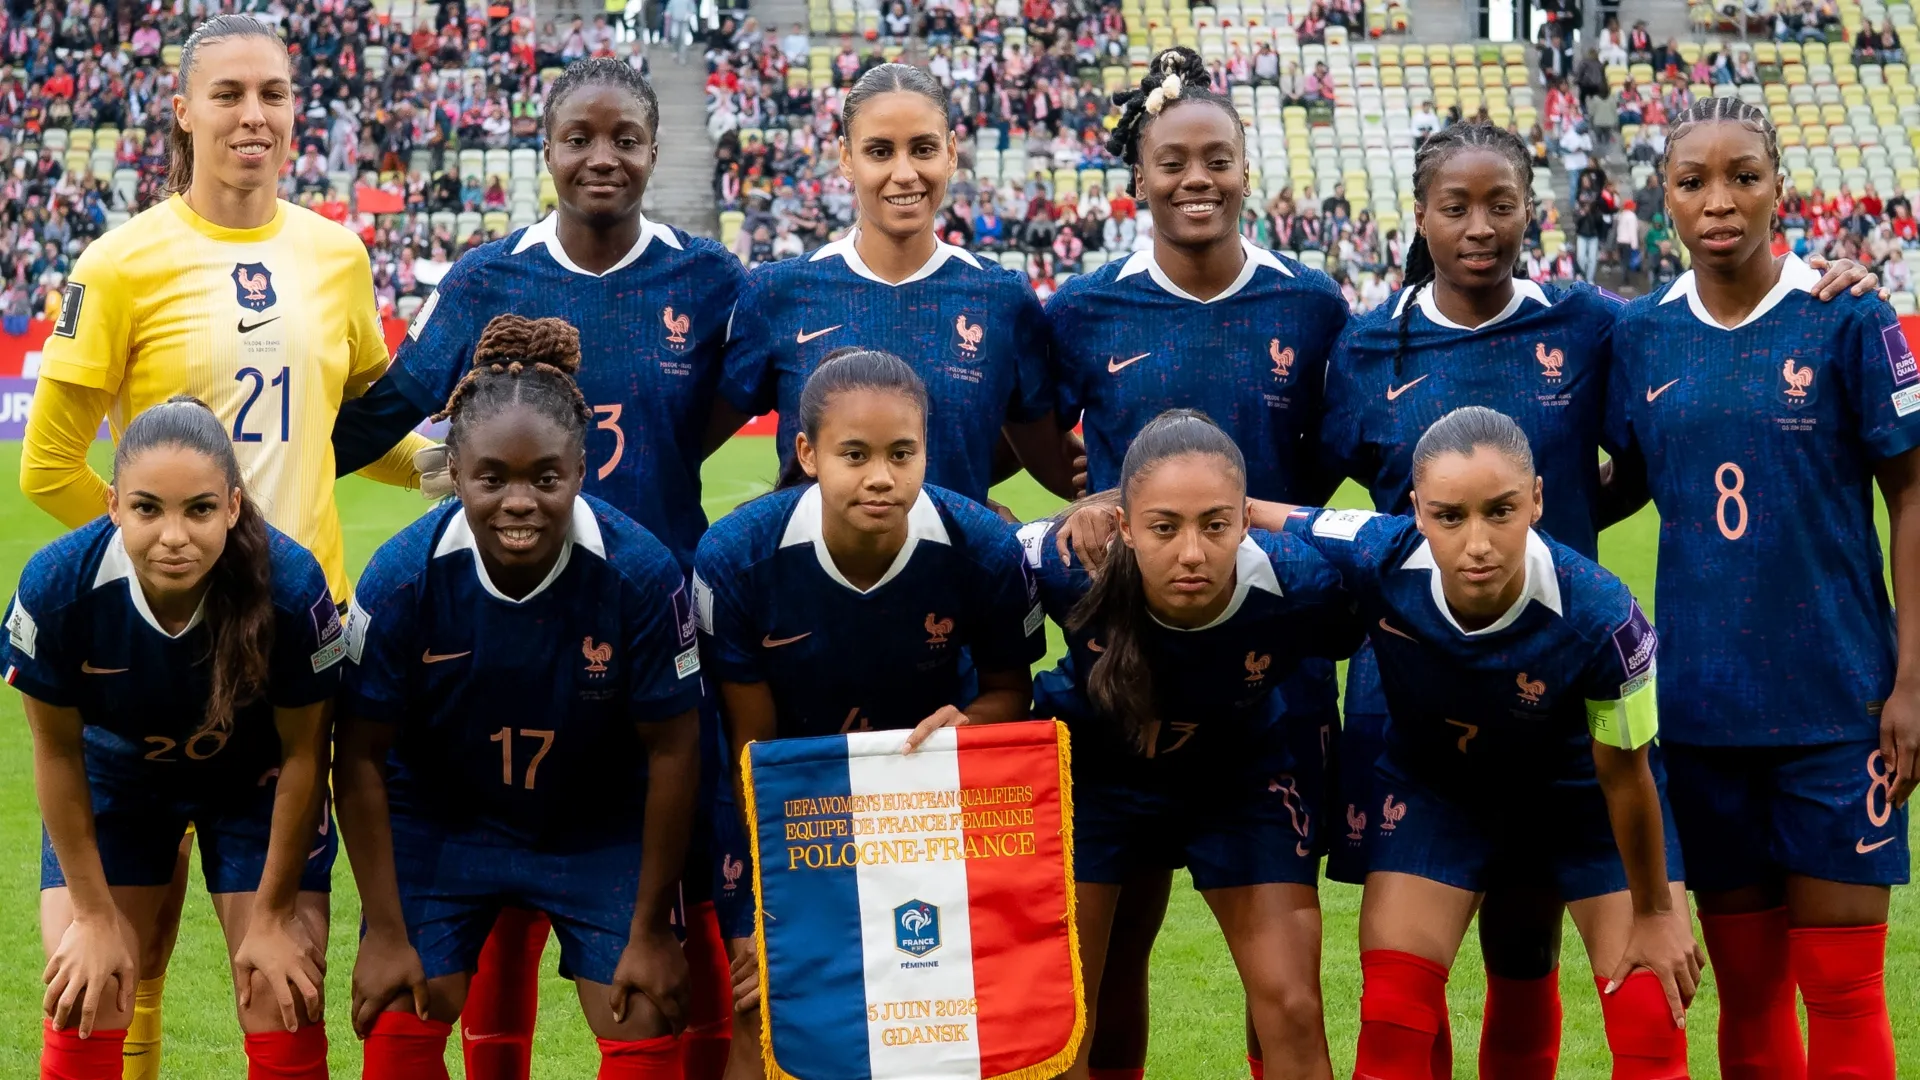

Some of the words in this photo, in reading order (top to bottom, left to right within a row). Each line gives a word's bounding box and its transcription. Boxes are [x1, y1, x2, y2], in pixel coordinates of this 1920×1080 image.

[232, 366, 290, 442] 21
[593, 404, 625, 480] 3
[1715, 462, 1748, 540] 8
[143, 730, 228, 762] 20
[1444, 718, 1478, 754] 7
[490, 726, 555, 789] 17
[784, 798, 819, 817] UEFA
[818, 793, 881, 815] WOMEN'S
[882, 789, 955, 810] EUROPEAN
[956, 785, 1033, 807] QUALIFIERS
[1866, 750, 1892, 827] 8
[785, 819, 848, 840] EQUIPE
[850, 817, 874, 836] DE
[878, 813, 947, 835] FRANCE
[949, 808, 1034, 830] FEMININE
[787, 832, 1036, 871] POLOGNE-FRANCE
[902, 937, 935, 947] FRANCE
[900, 960, 940, 969] FÉMININE
[867, 1003, 879, 1022] 5
[881, 1000, 932, 1020] JUIN
[935, 997, 978, 1017] 2026
[881, 1023, 970, 1046] GDANSK
